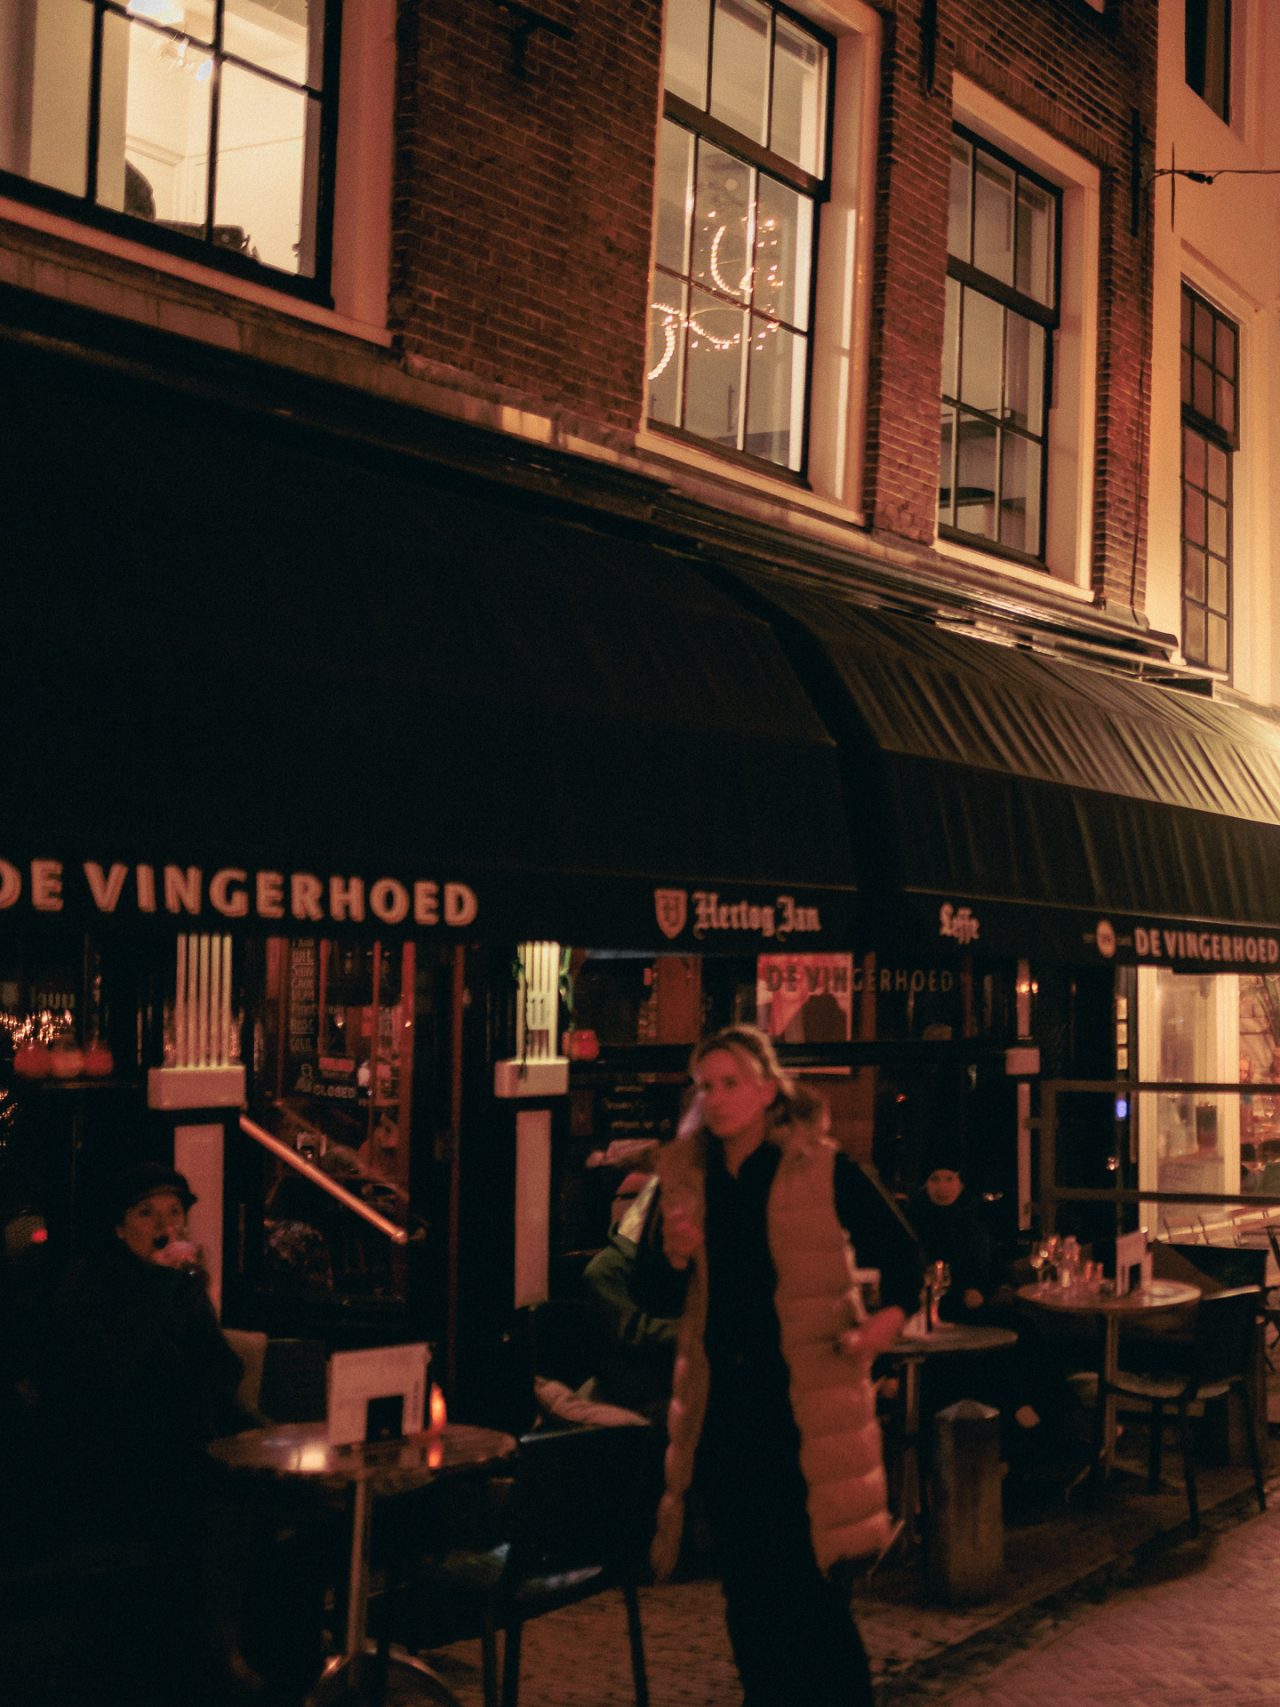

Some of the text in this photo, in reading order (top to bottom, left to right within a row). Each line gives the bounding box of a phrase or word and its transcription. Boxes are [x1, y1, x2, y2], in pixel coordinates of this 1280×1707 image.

[83, 860, 479, 927] VINGERHOED
[692, 890, 822, 941] Hertog Jan
[1134, 927, 1161, 957] DE
[1163, 930, 1280, 964] VINGERHOED
[766, 964, 954, 993] DE VINGERHOED
